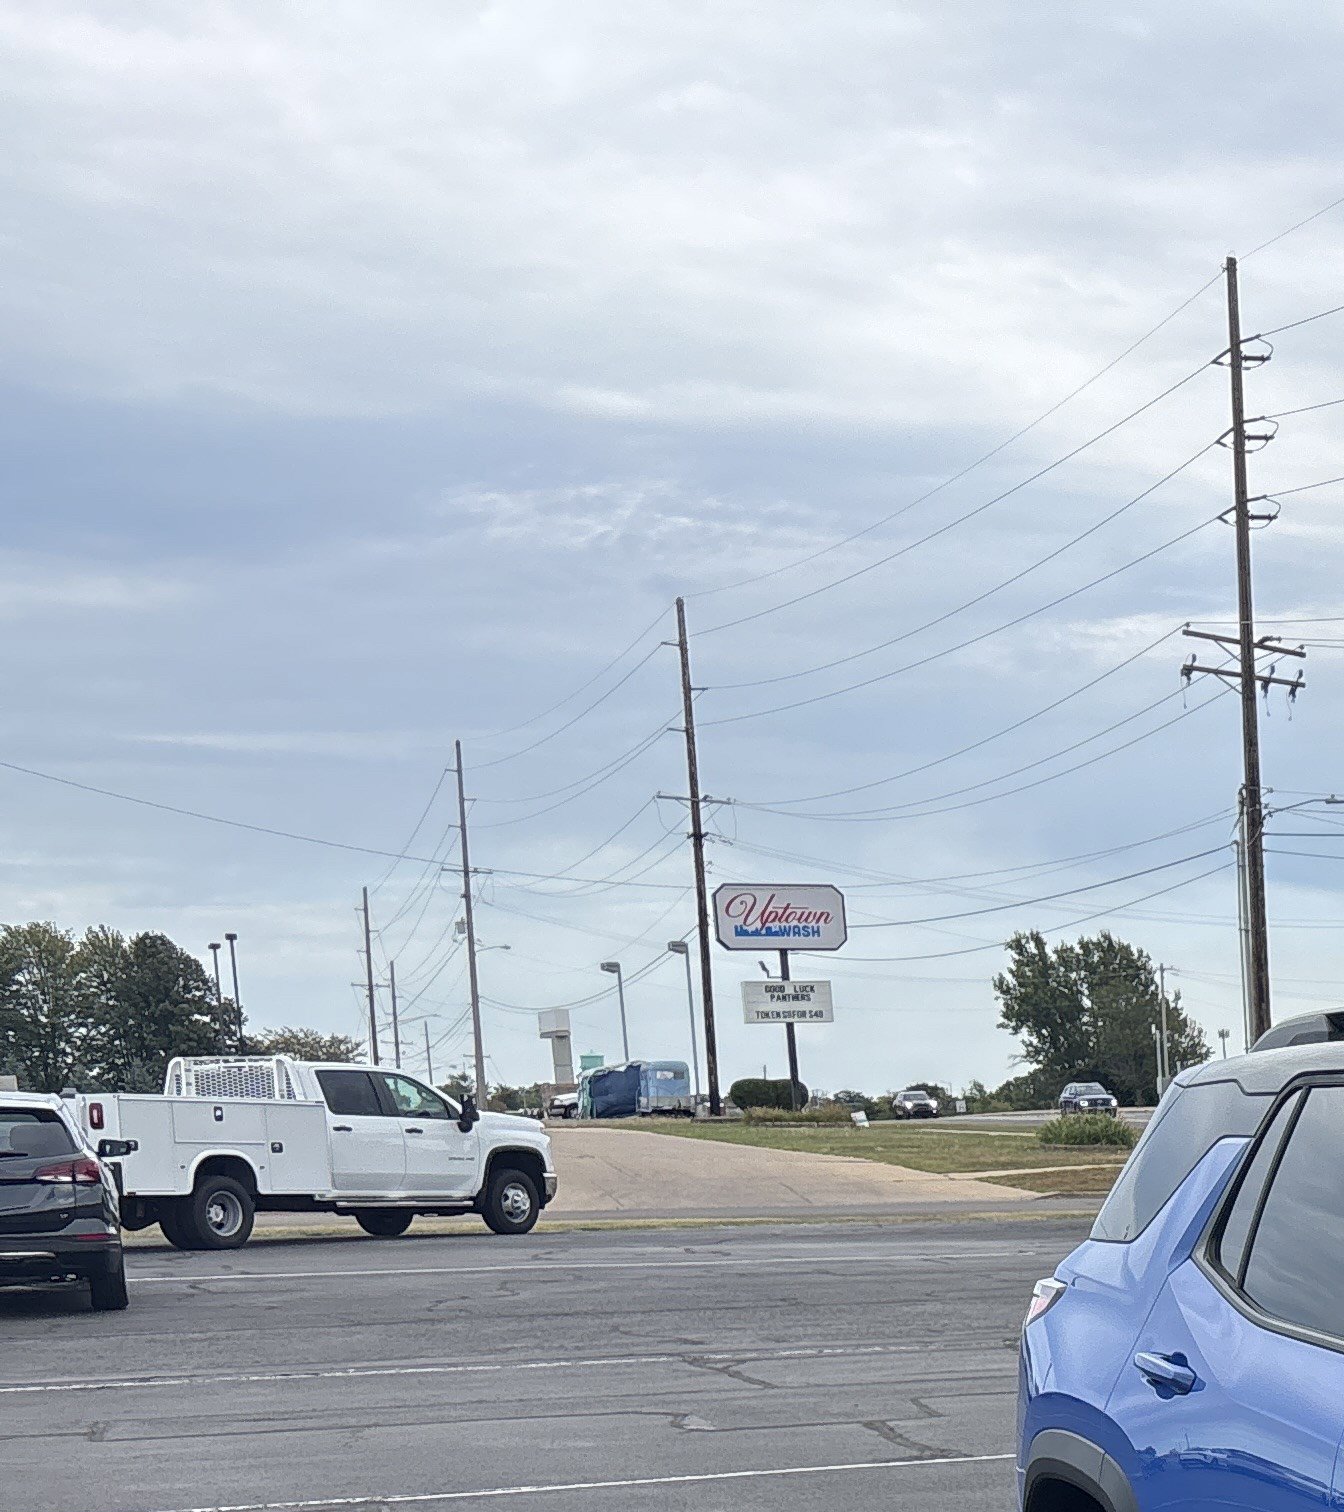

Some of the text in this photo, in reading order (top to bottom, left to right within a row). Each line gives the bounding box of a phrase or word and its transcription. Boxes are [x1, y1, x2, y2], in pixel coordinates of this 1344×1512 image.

[725, 893, 834, 930] Uptown
[779, 925, 821, 937] WASH
[765, 985, 815, 993] GOOD LUCK
[770, 994, 811, 1002] PANTHERS
